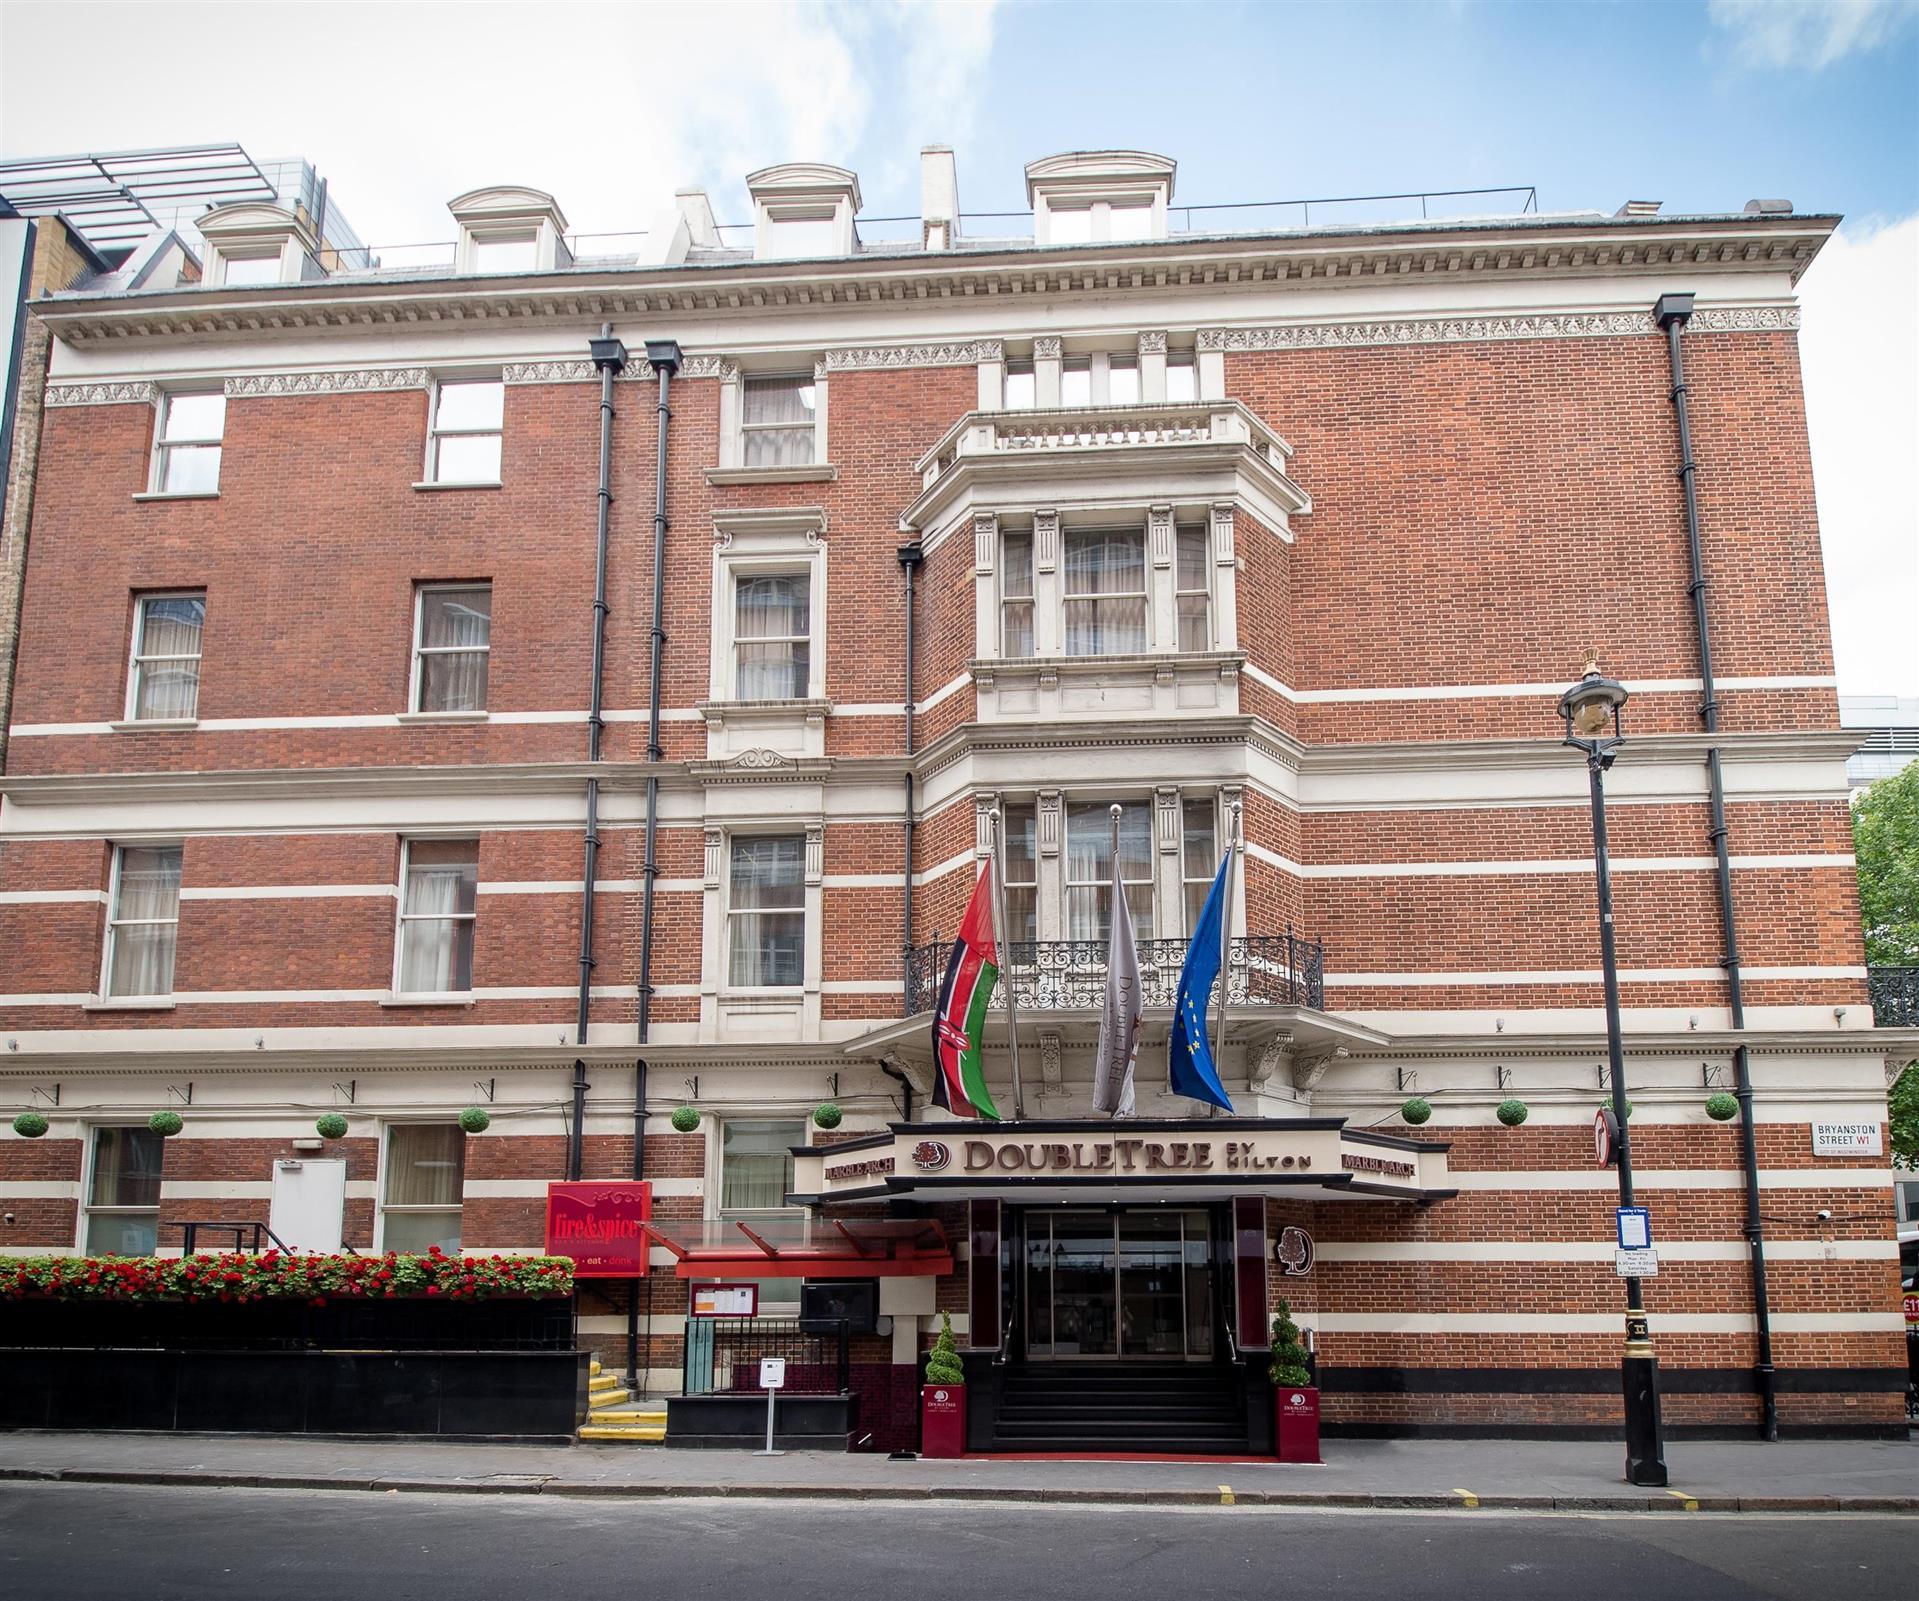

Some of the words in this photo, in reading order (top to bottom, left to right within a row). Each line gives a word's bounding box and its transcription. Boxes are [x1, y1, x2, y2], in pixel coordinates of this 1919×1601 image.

[1818, 1125, 1876, 1134] BRYANSTON
[1819, 1135, 1853, 1145] STREET
[1856, 1135, 1870, 1145] W1
[1226, 1142, 1255, 1154] BY
[963, 1140, 1214, 1170] DOUBLETREE
[1227, 1156, 1311, 1168] HILTON
[1341, 1154, 1387, 1172] MARBLE
[1387, 1161, 1416, 1177] ARCH
[824, 1163, 864, 1180] MARBLE
[865, 1157, 895, 1174] ARCH
[555, 1213, 638, 1244] fire&spice
[587, 1257, 602, 1265] eat
[608, 1255, 632, 1265] drink
